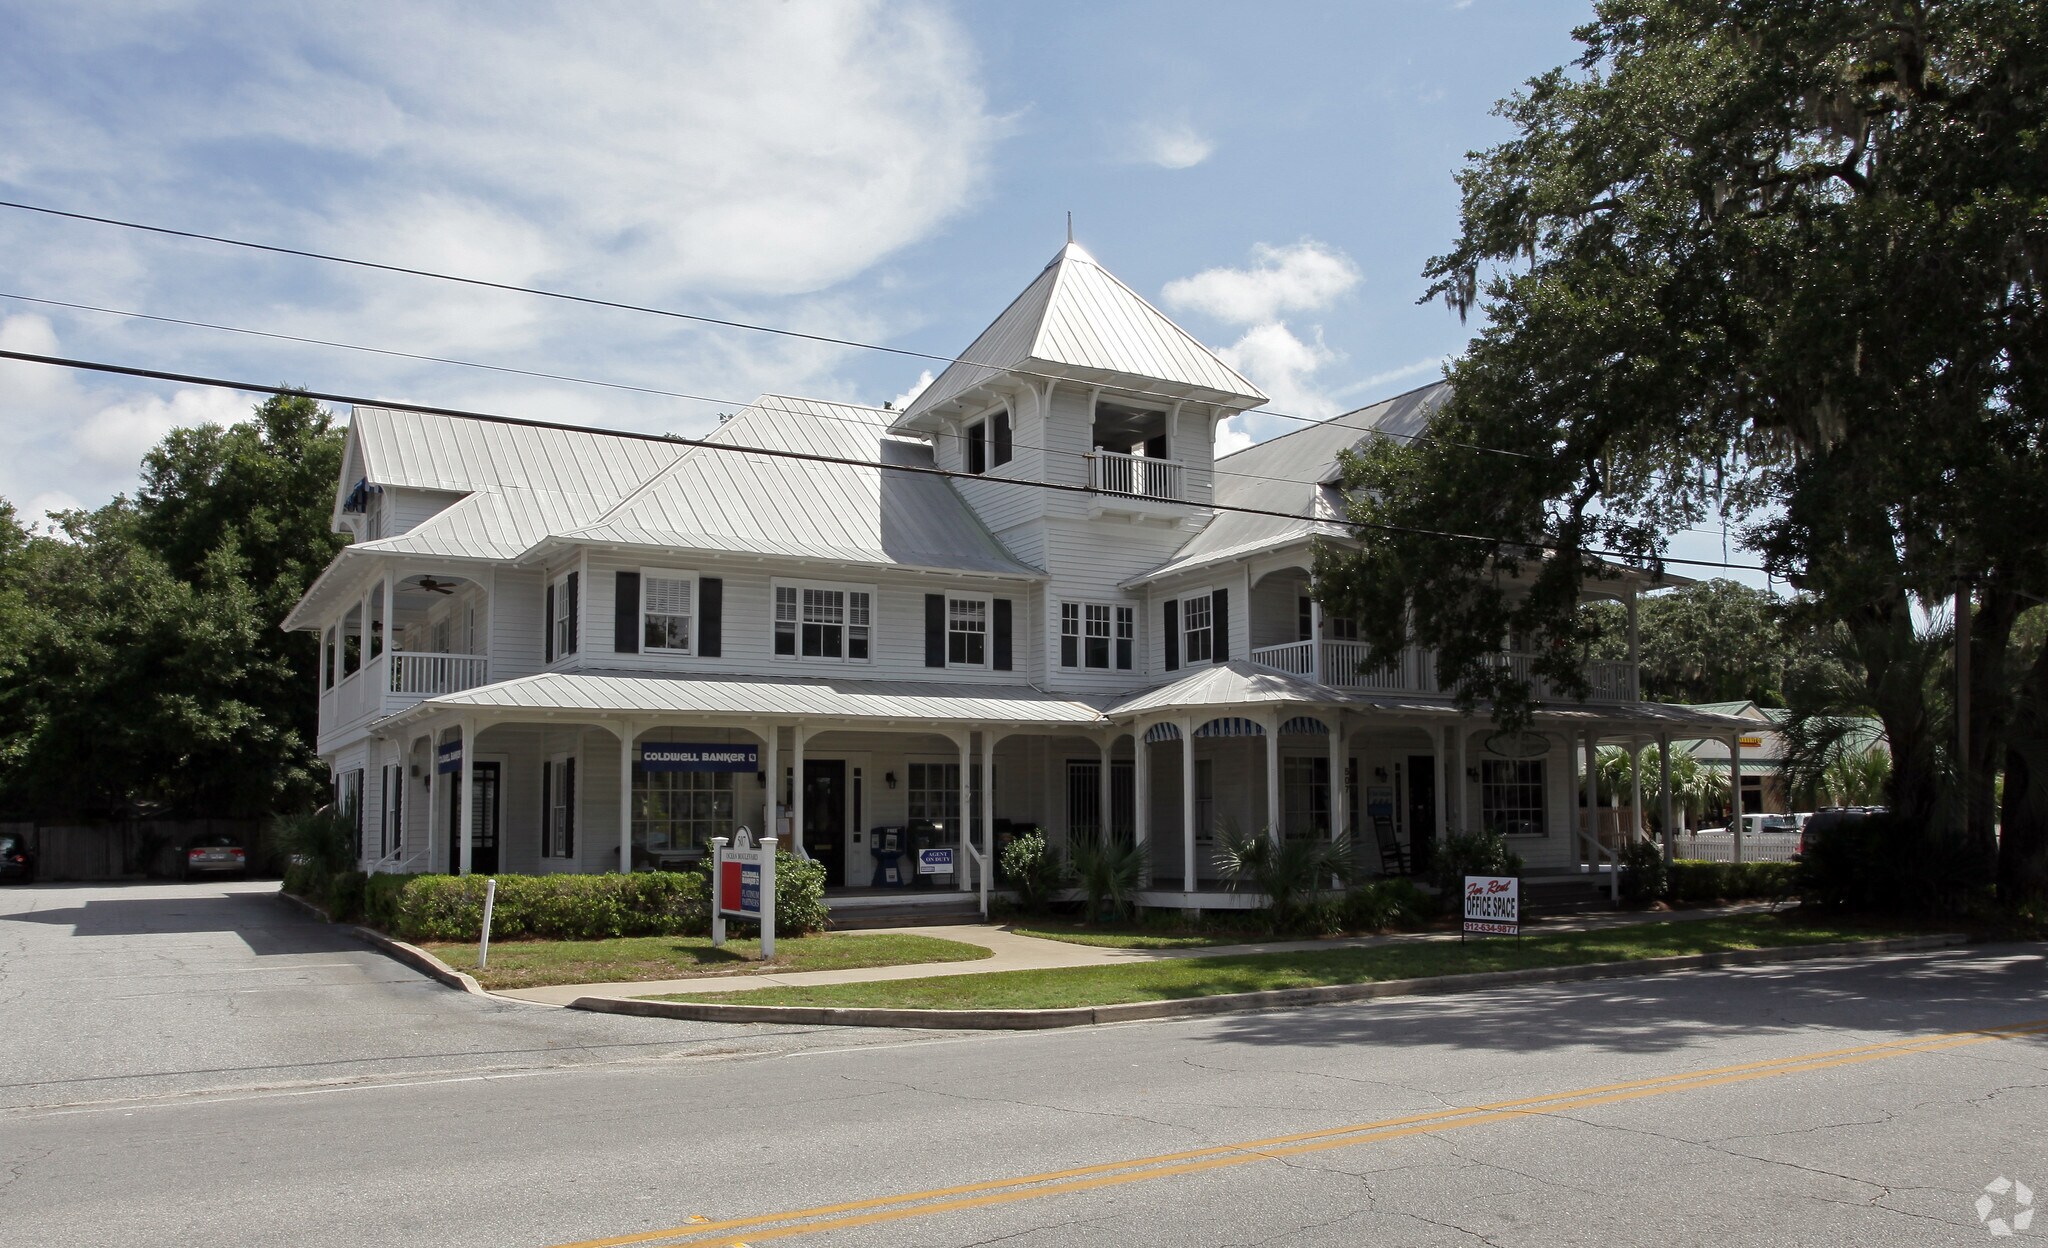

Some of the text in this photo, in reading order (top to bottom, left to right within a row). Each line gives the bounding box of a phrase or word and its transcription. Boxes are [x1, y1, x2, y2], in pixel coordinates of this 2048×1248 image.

[643, 752, 745, 763] COLDWELL BANKER
[1467, 880, 1511, 899] For Rent
[1466, 896, 1516, 918] OFFICE SPACE
